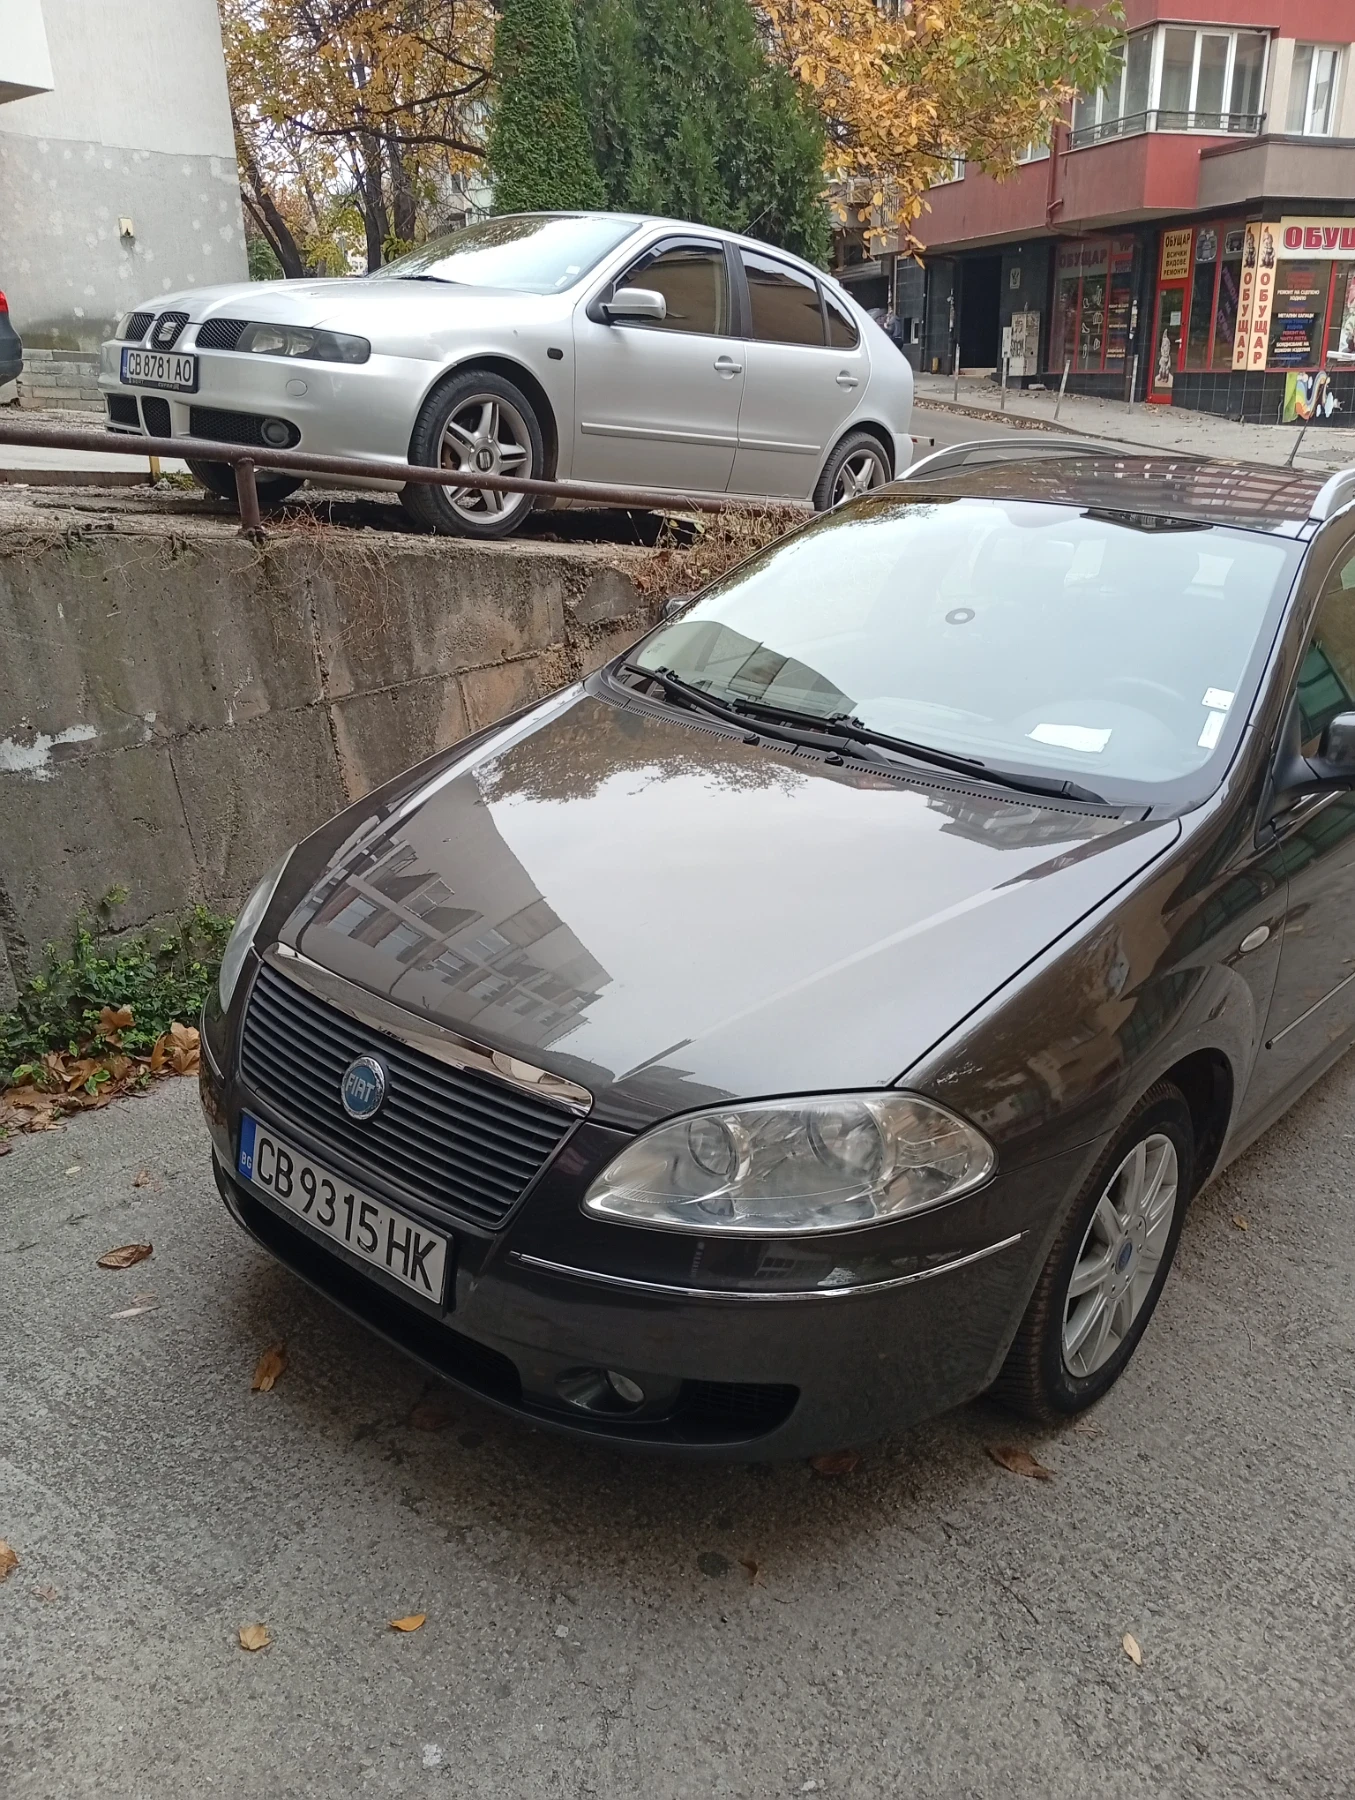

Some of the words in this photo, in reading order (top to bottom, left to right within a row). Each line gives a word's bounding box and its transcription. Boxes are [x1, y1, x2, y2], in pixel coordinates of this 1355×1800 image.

[1165, 233, 1190, 248] ОБУЩАР
[1165, 258, 1187, 267] ВИДОВЕ
[1166, 250, 1187, 259] ВСИЧКИ
[1163, 267, 1187, 276] РЕМОНТИ
[1237, 272, 1252, 363] ОБУЩАР
[1253, 273, 1271, 364] ОБУЩАР
[128, 353, 142, 376] CB
[143, 355, 171, 380] 8781
[174, 358, 192, 382] AO
[345, 1072, 376, 1103] FIAT
[240, 1150, 253, 1169] BG
[257, 1137, 294, 1198] CB
[300, 1167, 379, 1254] 9315
[385, 1218, 437, 1293] HK
